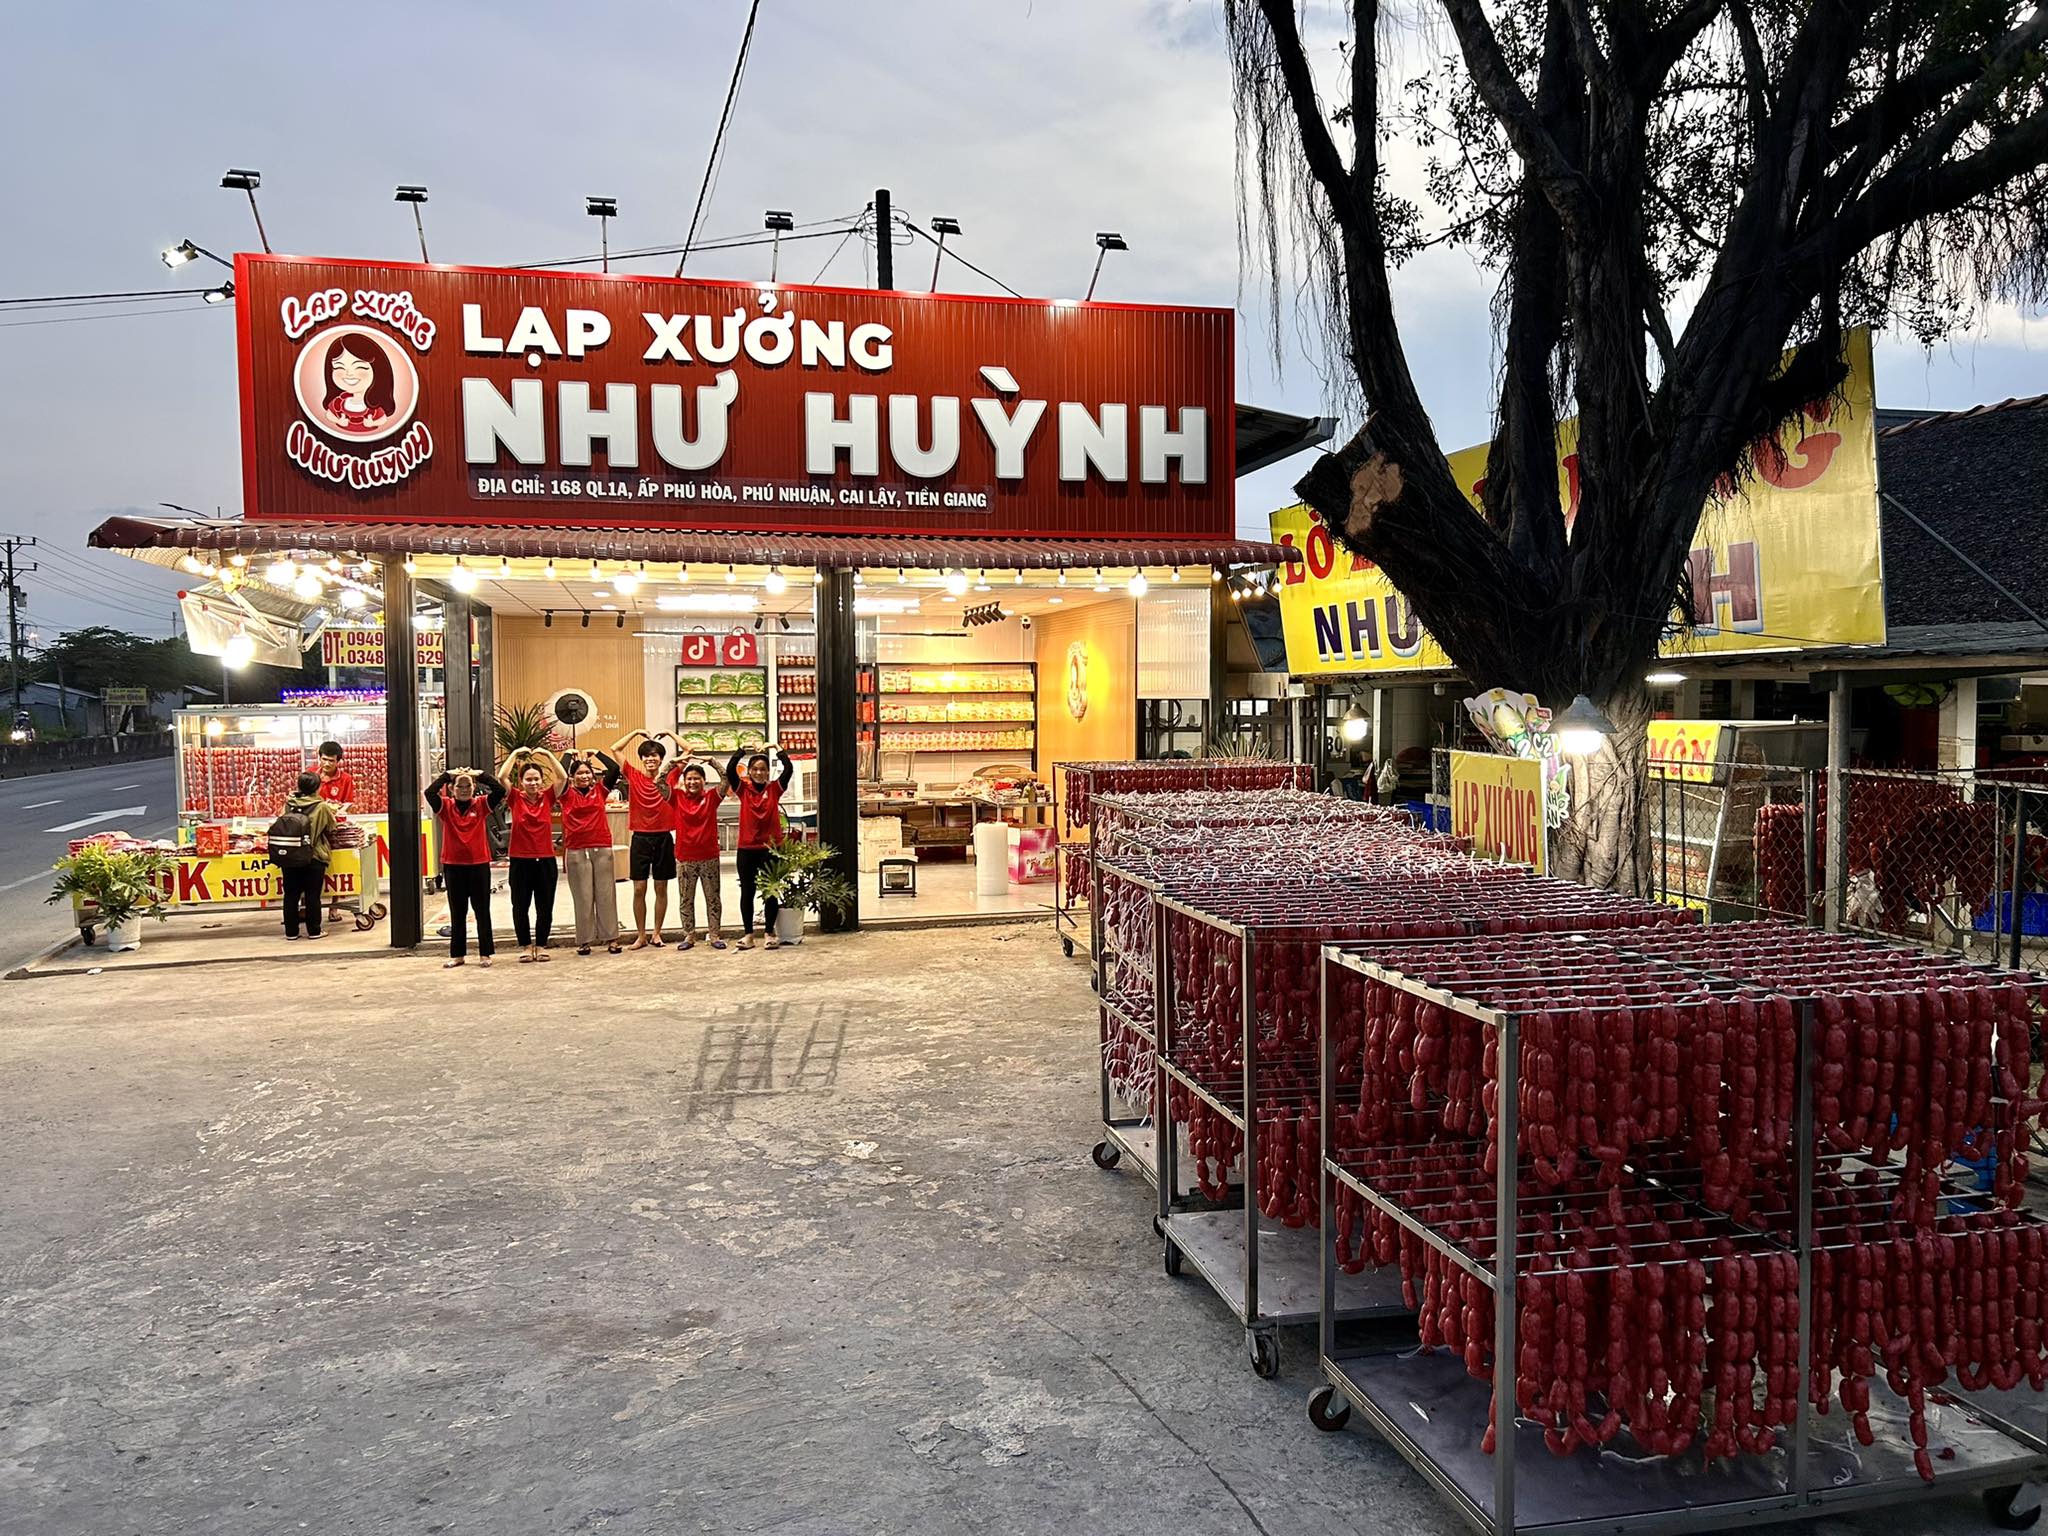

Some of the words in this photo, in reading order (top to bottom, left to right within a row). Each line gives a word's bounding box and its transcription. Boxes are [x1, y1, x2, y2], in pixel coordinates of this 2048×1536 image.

[284, 291, 345, 335] LẠP
[353, 291, 434, 348] XƯỞNG
[463, 304, 612, 367] LẠP
[642, 292, 894, 371] XƯỞNG
[462, 369, 739, 470] NHƯ
[805, 365, 1207, 485] HUỲNH
[288, 421, 349, 481] NHƯ
[478, 478, 507, 497] ĐỊA
[511, 475, 545, 494] CHỈ:
[551, 480, 582, 495] 168
[586, 481, 633, 499] QL1A,
[638, 478, 659, 498] ẤP
[664, 481, 696, 499] PHÚ
[701, 481, 738, 503] HÒA,
[743, 483, 774, 502] PHÚ
[779, 485, 835, 506] NHUẬN,
[839, 489, 864, 504] CAI
[869, 487, 902, 508] LẬY,
[906, 486, 940, 505] TIỀN
[944, 492, 987, 508] GIANG
[347, 632, 384, 646] 0949
[416, 632, 443, 647] 807
[347, 650, 384, 665] 0348
[416, 650, 444, 665] 629
[222, 873, 271, 898] NHƯ
